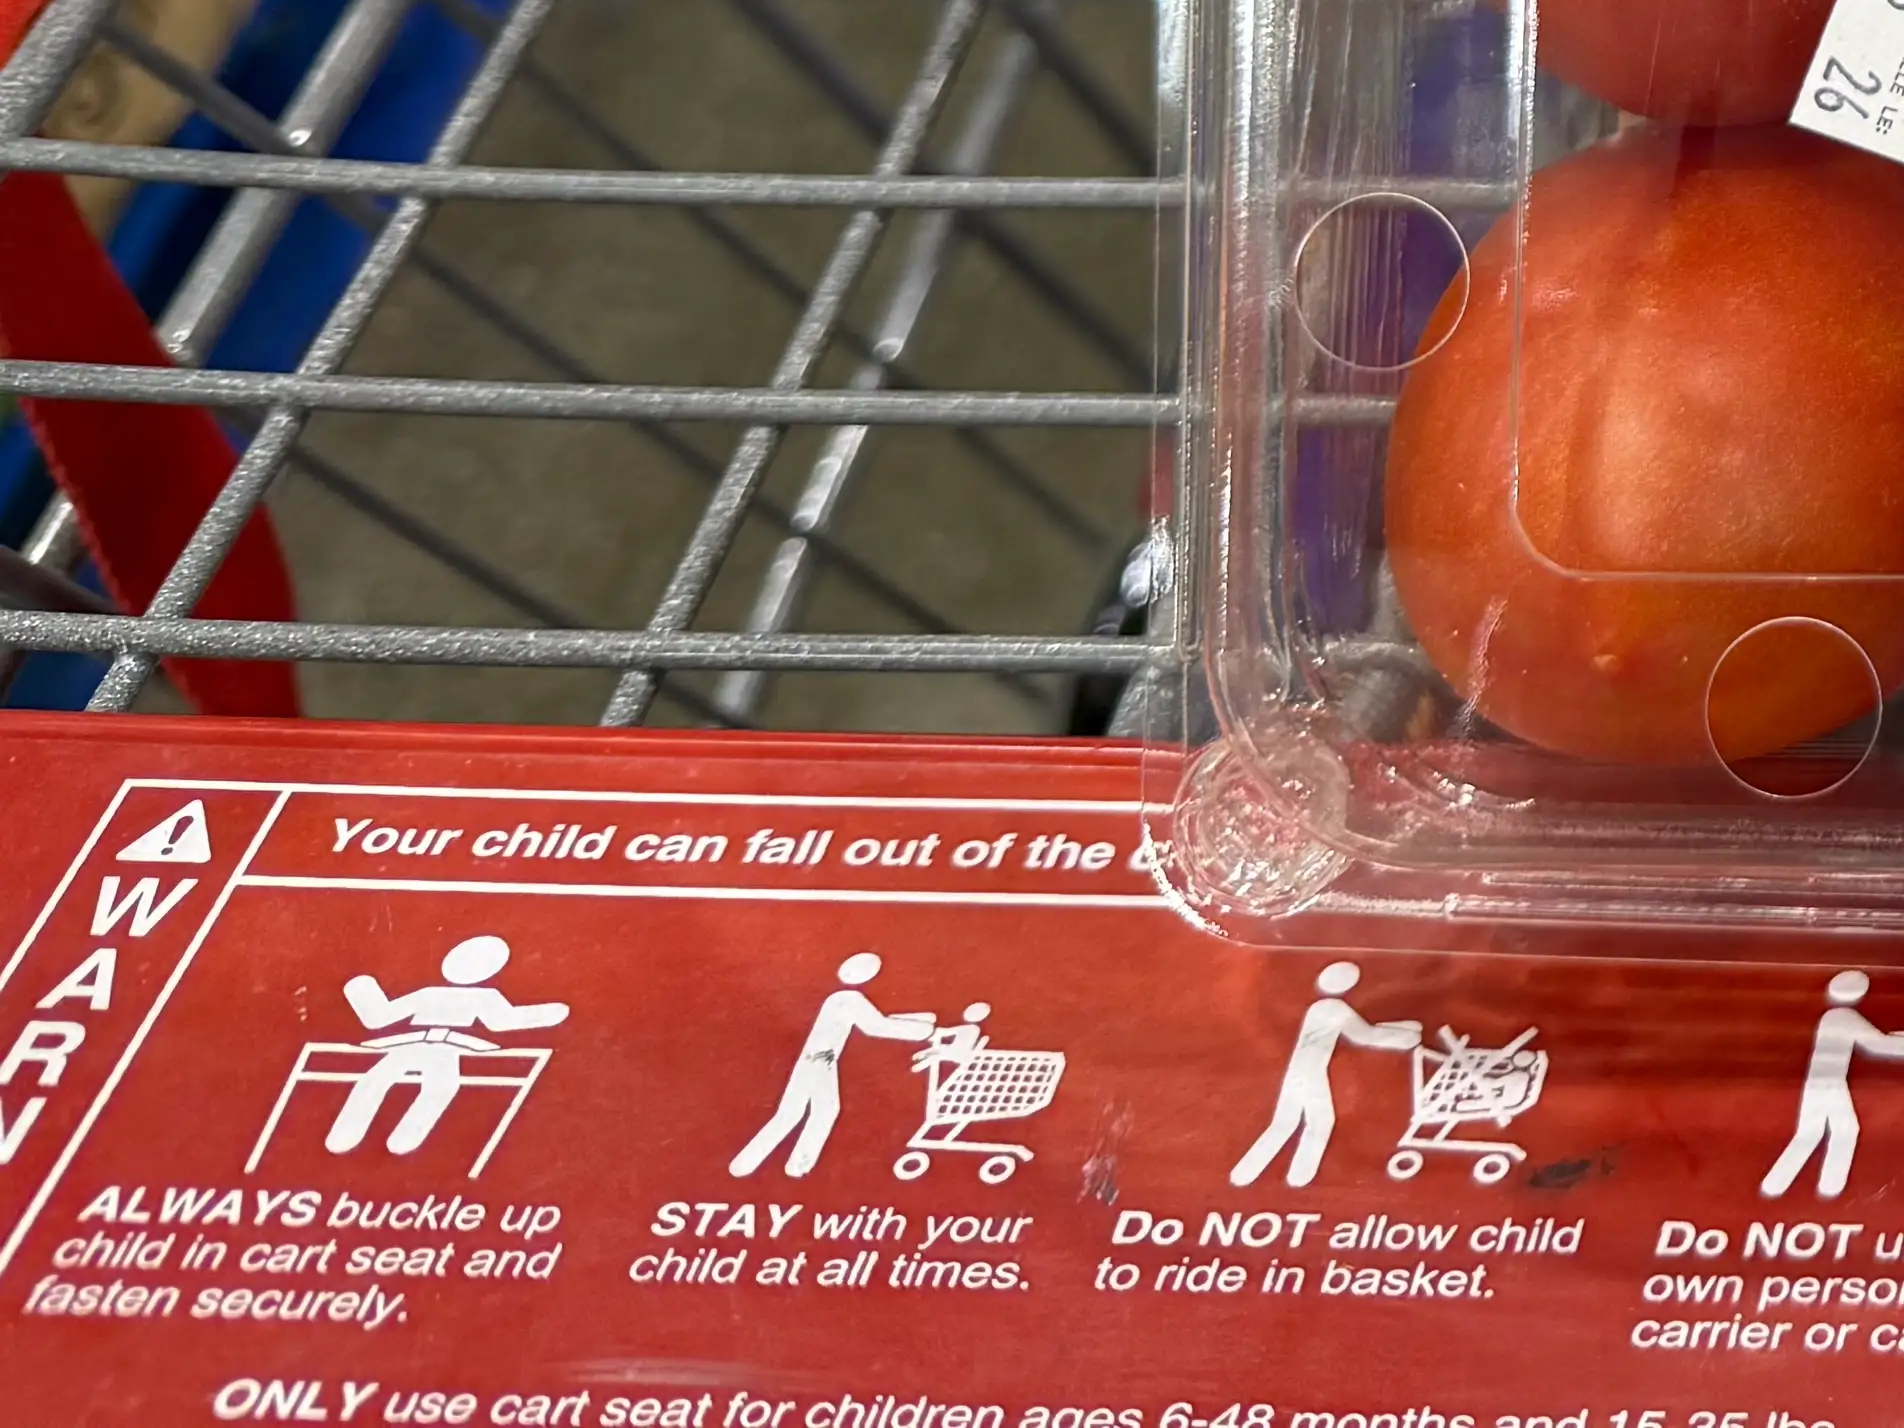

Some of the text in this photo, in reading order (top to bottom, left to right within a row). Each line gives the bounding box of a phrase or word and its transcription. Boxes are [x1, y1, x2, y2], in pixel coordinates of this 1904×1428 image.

[1814, 55, 1883, 120] 26
[333, 819, 463, 855] Your
[472, 824, 617, 859] child
[625, 834, 728, 862] can
[743, 829, 833, 865] fall
[843, 834, 940, 866] out
[952, 833, 1017, 868] of
[1025, 834, 1115, 870] the
[79, 1186, 560, 1240] ALWAYS buckle up
[651, 1202, 1033, 1250] STAY with your
[1112, 1211, 1584, 1253] Do NOT allow child
[53, 1231, 562, 1278] child in cart seat and
[1656, 1221, 1728, 1257] Do
[1744, 1223, 1863, 1259] NOT
[629, 1248, 1028, 1289] child at all times.
[1095, 1257, 1493, 1298] to ride in basket.
[1643, 1275, 1743, 1303] own
[25, 1275, 406, 1330] fasten securely.
[1632, 1314, 1792, 1350] carrier
[1805, 1323, 1858, 1351] or
[214, 1379, 378, 1420] ONLY
[384, 1392, 477, 1423] use
[491, 1391, 590, 1426] cart
[600, 1394, 712, 1428] seat
[723, 1392, 795, 1428] for
[805, 1394, 1004, 1428] children
